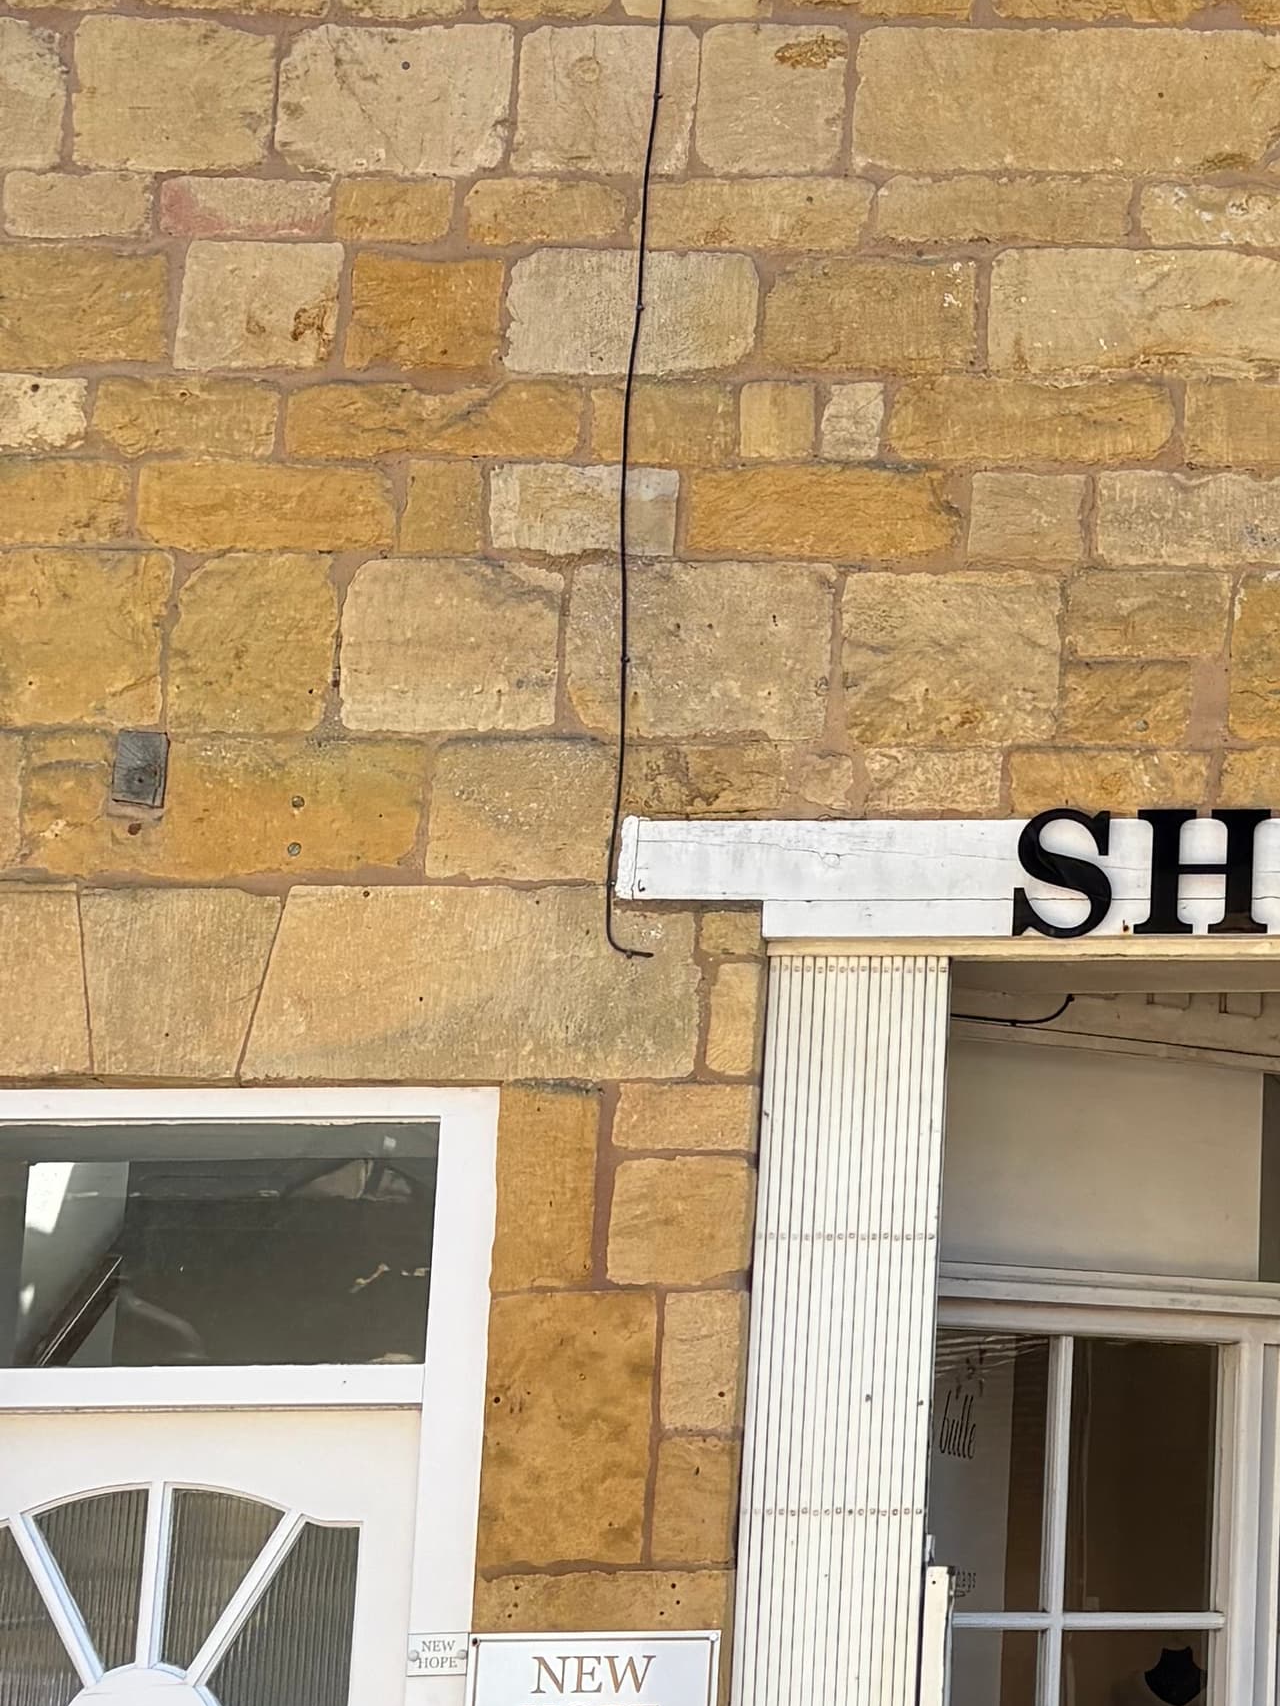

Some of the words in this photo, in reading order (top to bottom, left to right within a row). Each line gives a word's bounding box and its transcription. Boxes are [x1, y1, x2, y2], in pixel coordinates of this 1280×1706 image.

[421, 1640, 456, 1653] NEW
[418, 1656, 458, 1670] HOPE
[531, 1655, 656, 1694] NEW
